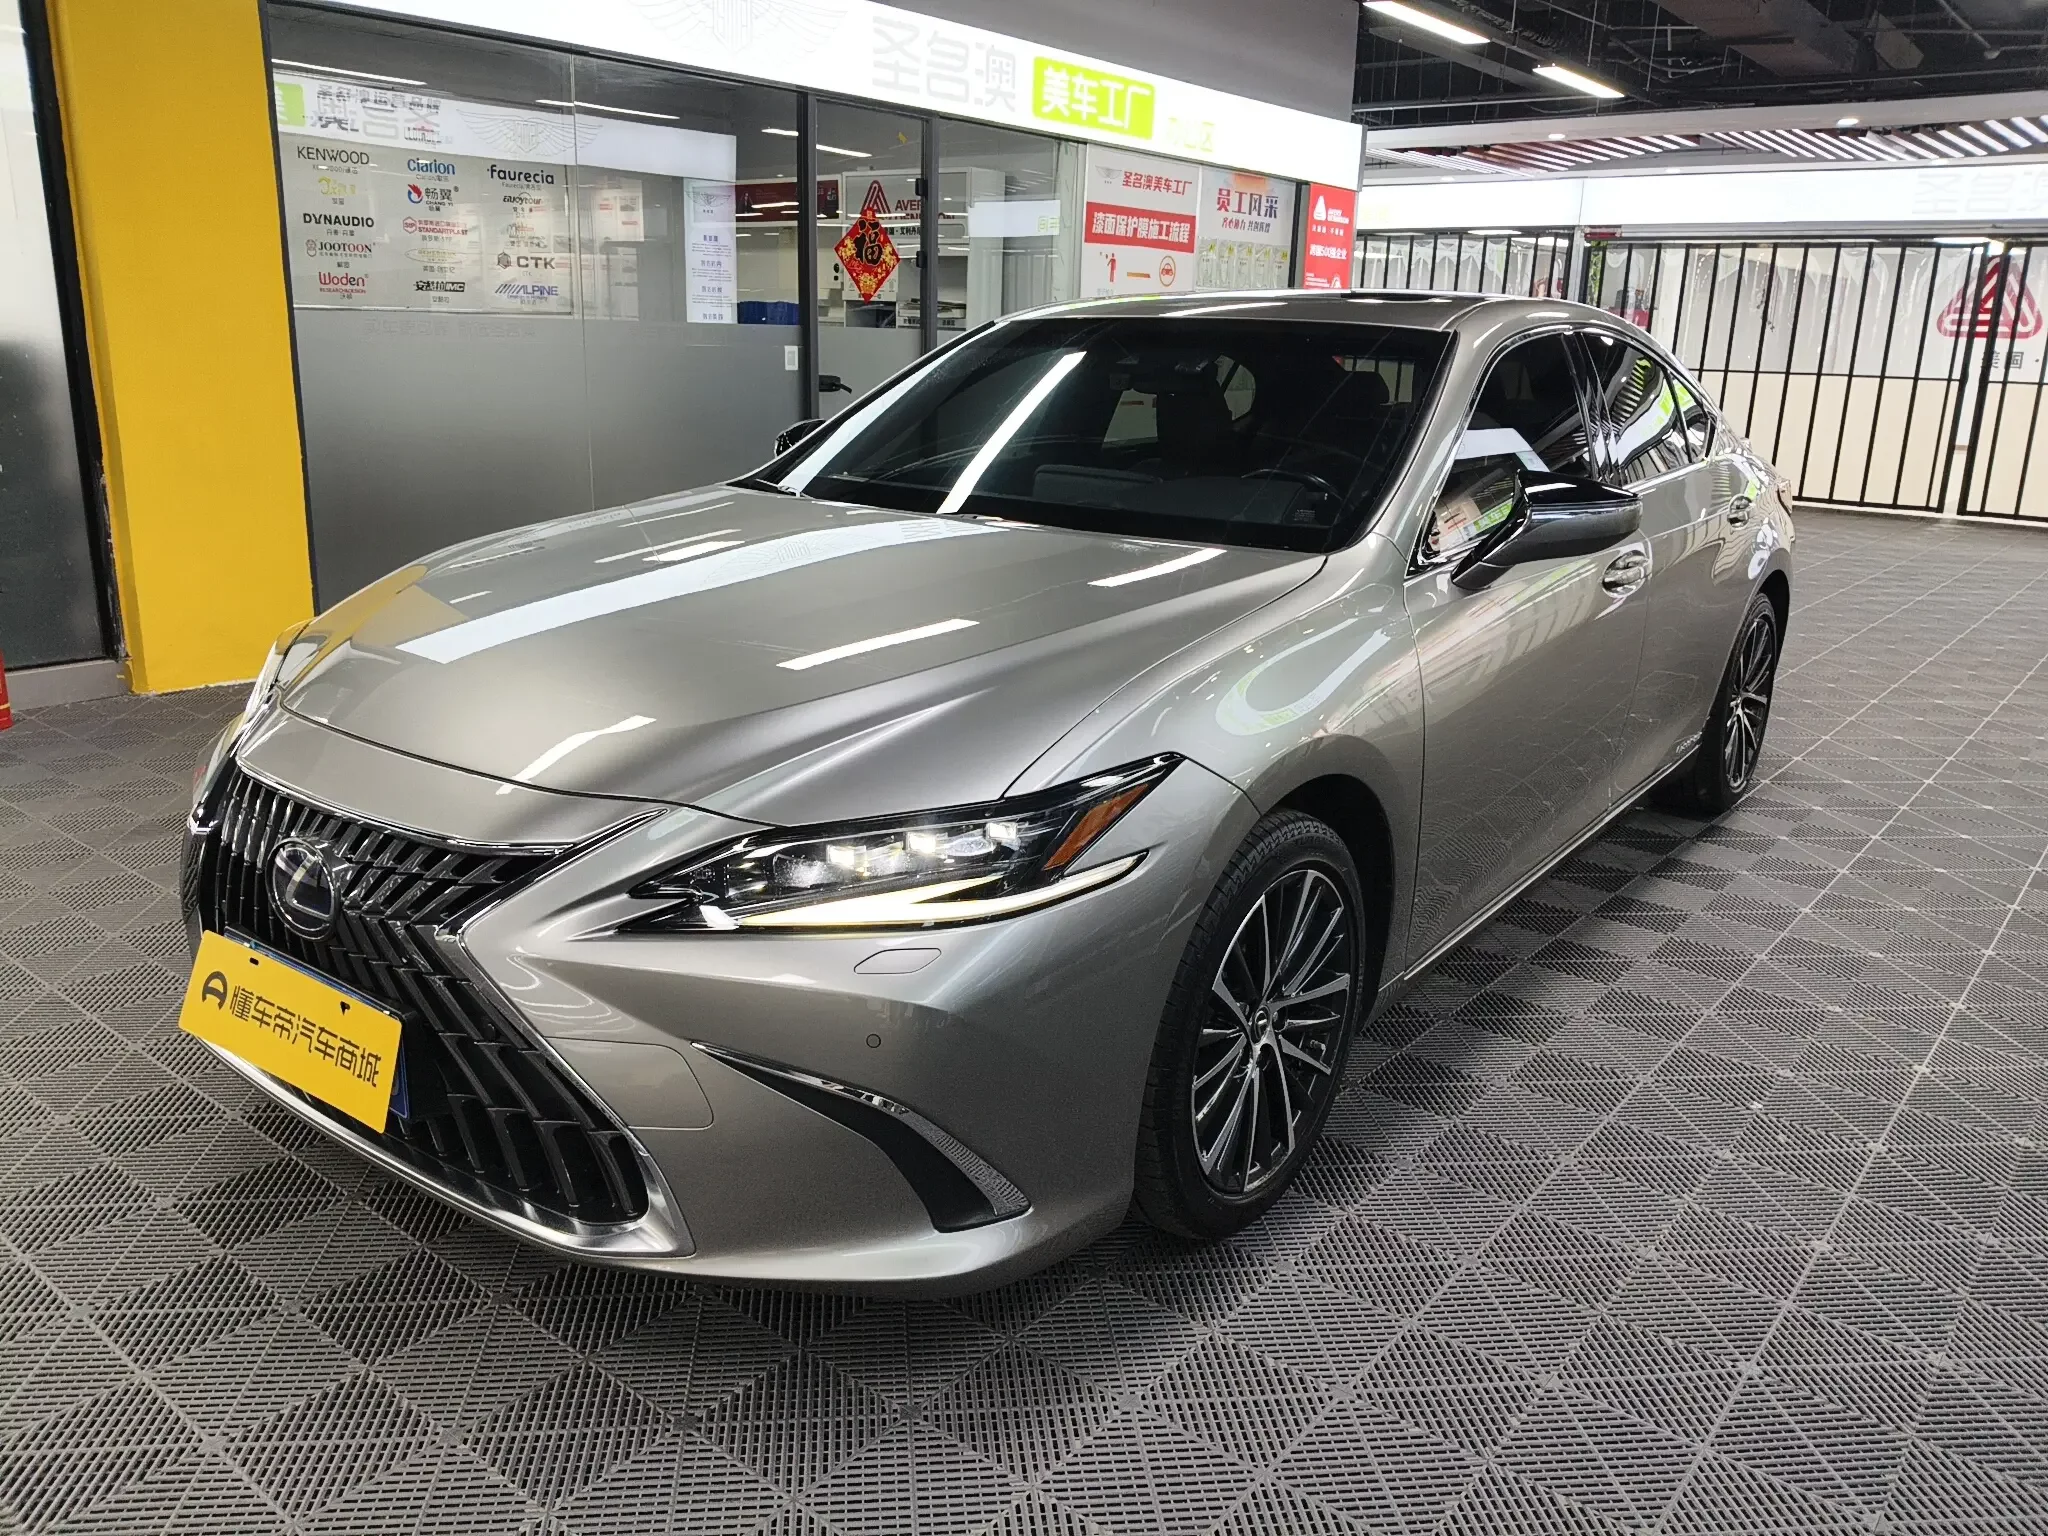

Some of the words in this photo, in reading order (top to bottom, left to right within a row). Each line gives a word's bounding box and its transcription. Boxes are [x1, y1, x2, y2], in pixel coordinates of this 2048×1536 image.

[872, 15, 1016, 113] 圣名澳
[1042, 65, 1150, 130] 美车工厂
[297, 146, 370, 165] KENWOOD
[490, 165, 555, 185] faurecia
[1122, 170, 1193, 197] 圣名澳美车工厂
[425, 187, 453, 201] 畅翼
[1216, 187, 1279, 219] 员工风采
[895, 199, 921, 211] AVE
[303, 213, 375, 228] DYNAUDIO
[1091, 211, 1191, 244] 漆面保护膜施工流程
[318, 242, 372, 253] JOOTOON
[516, 256, 556, 269] CTK
[318, 271, 366, 287] Woden
[229, 985, 382, 1088] 懂车帝汽车商城
